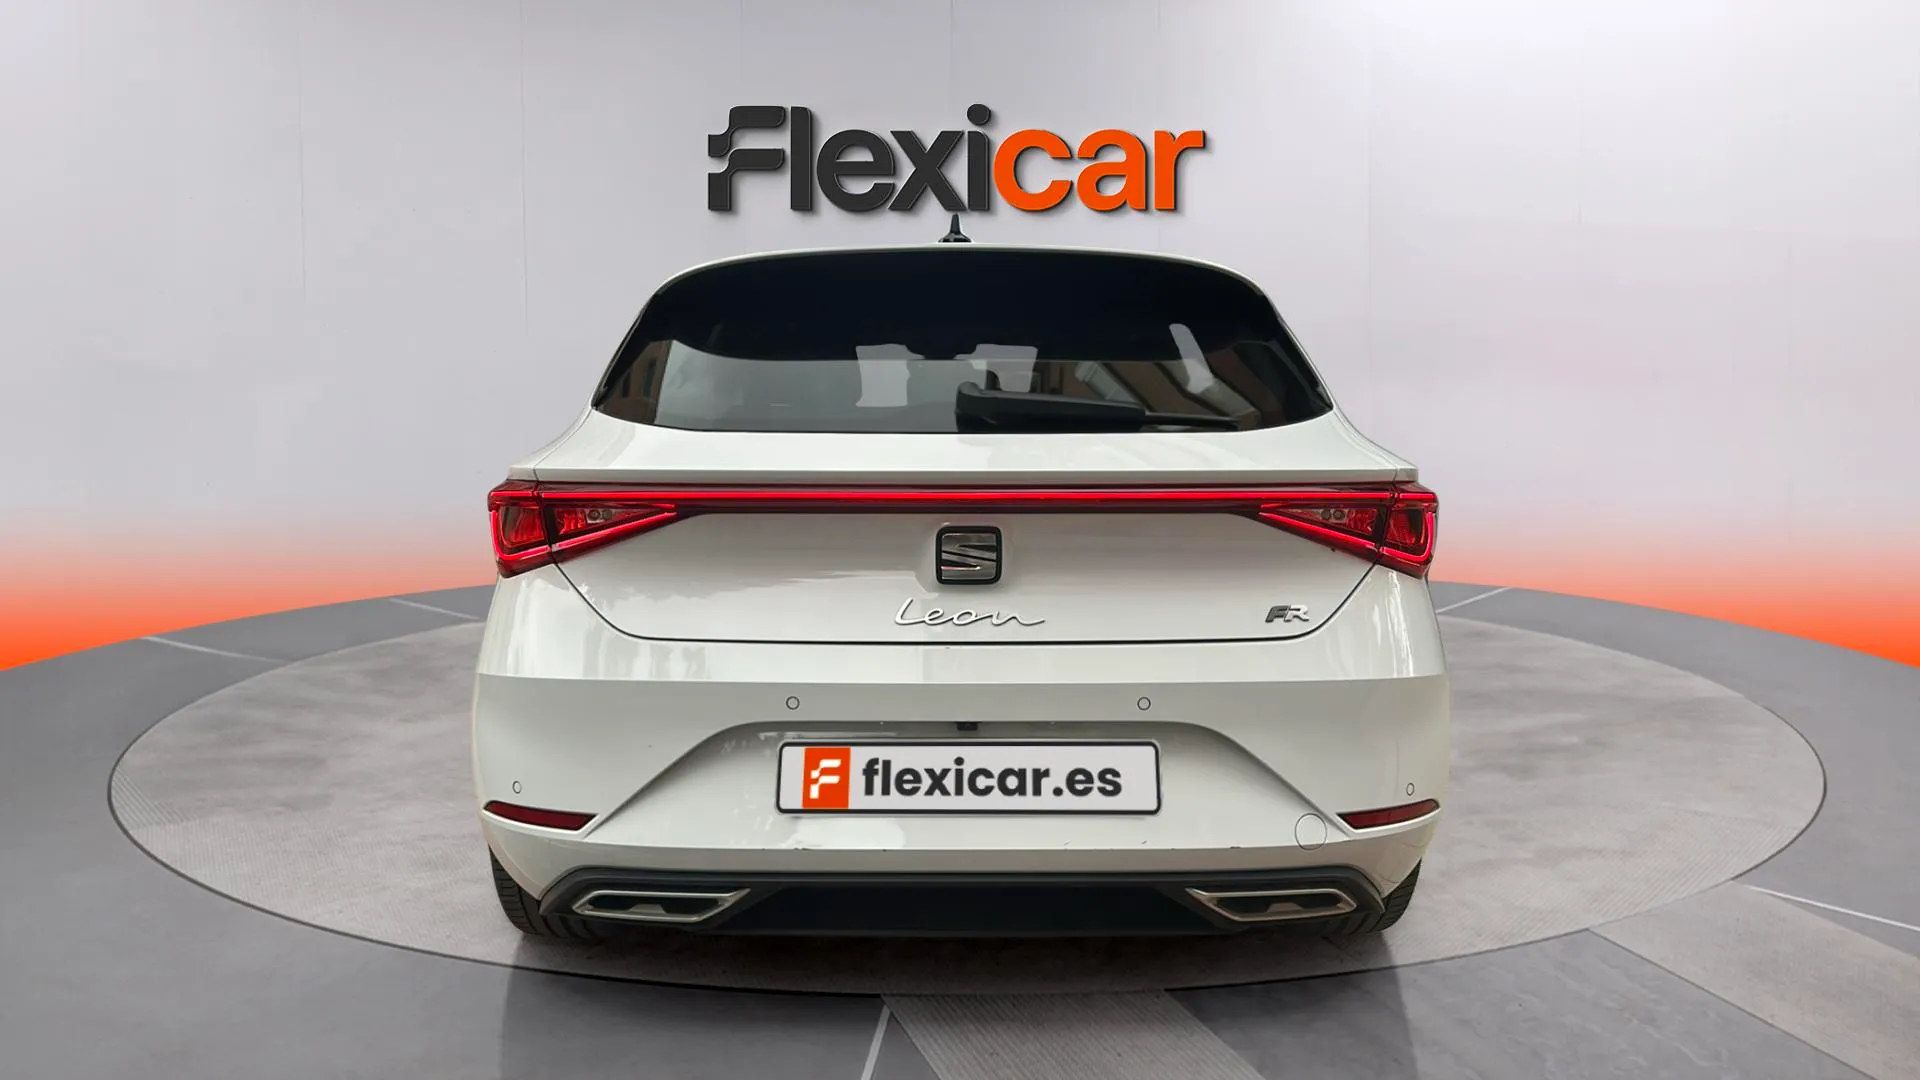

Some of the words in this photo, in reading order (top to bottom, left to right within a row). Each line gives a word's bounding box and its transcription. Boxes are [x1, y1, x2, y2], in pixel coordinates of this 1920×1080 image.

[708, 104, 1205, 212] Flexicar
[895, 597, 1045, 626] Leon
[1265, 605, 1309, 623] FR
[862, 756, 1122, 797] flexicar.es
